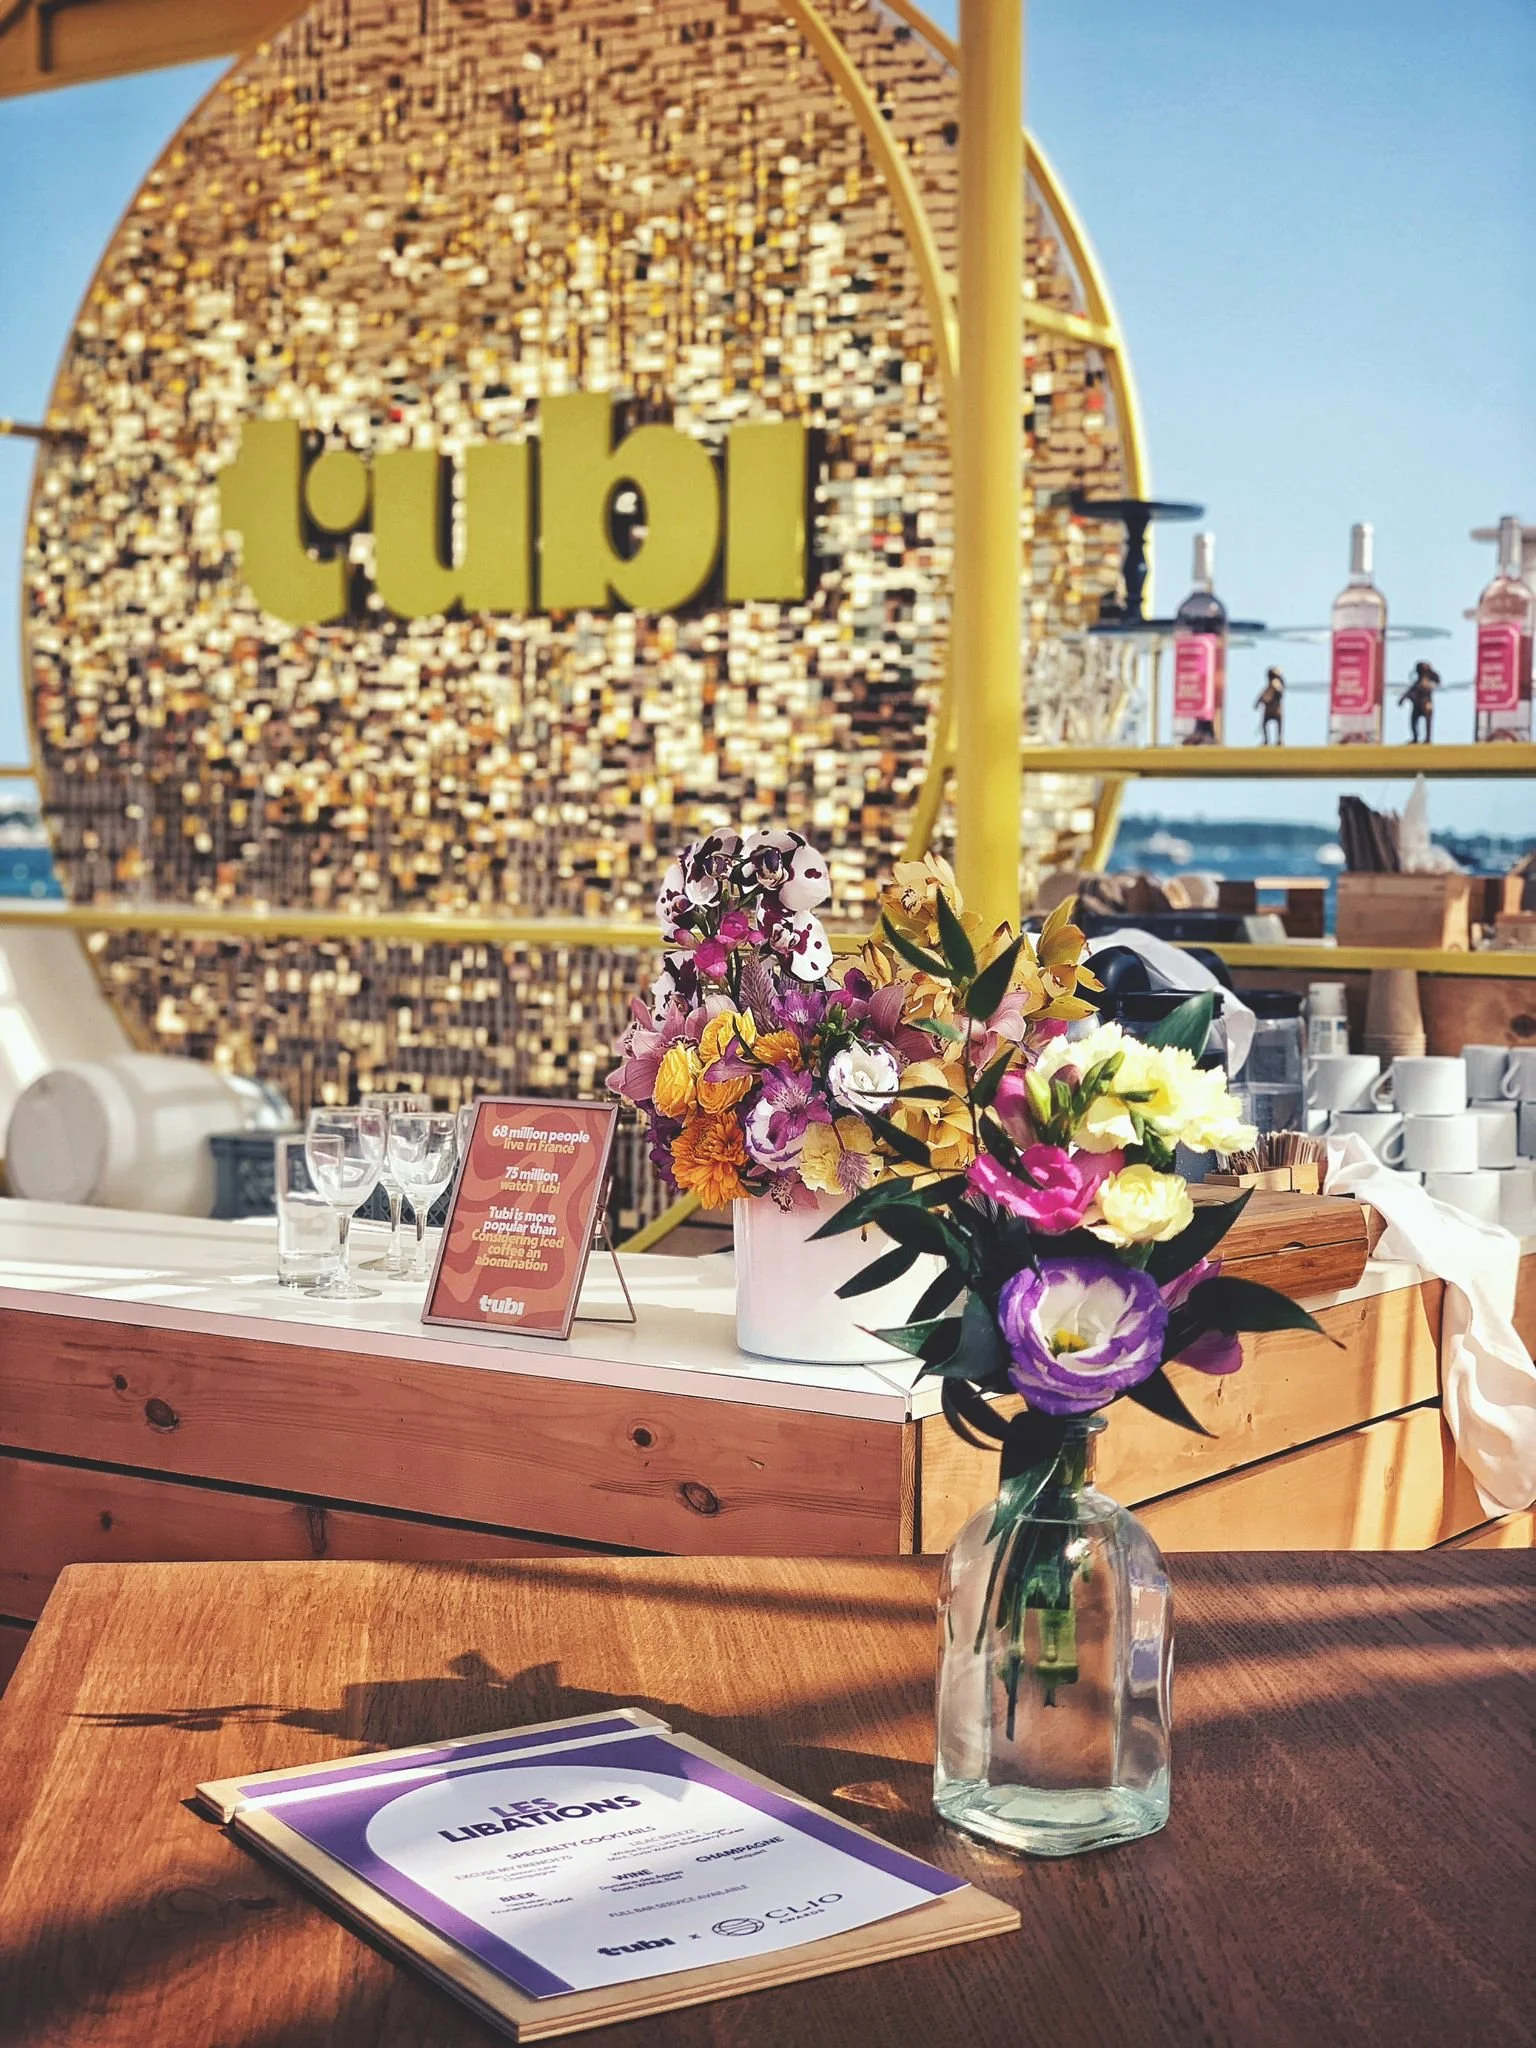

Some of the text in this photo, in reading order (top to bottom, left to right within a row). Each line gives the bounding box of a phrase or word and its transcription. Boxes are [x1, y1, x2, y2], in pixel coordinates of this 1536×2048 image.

[218, 388, 806, 624] tubi
[492, 1125, 590, 1144] 68 million people
[503, 1137, 575, 1154] live in France
[505, 1166, 558, 1182] 75 million
[500, 1180, 561, 1195] watch Tubi
[489, 1206, 556, 1224] Tubi is more
[483, 1220, 557, 1236] popular than
[471, 1229, 565, 1249] Considering iced
[487, 1243, 541, 1259] coffee an
[475, 1253, 549, 1272] abomination
[479, 1294, 525, 1316] tubi
[489, 1797, 560, 1818] LES
[438, 1795, 642, 1842] LIBATIONS
[507, 1826, 656, 1859] SPECIALTY COCKTAILS
[695, 1836, 785, 1862] CHAMPAGNE
[455, 1870, 496, 1880] EXCUSE
[497, 1865, 516, 1873] MY
[516, 1858, 561, 1870] FRENCH
[612, 1868, 653, 1881] WINE
[499, 1891, 539, 1902] BEER
[608, 1884, 749, 1917] FULL BAR SERVICE AVAILABLE
[597, 1937, 677, 1957] tubi
[765, 1893, 844, 1920] CLIO
[778, 1908, 826, 1924] AWARDS
